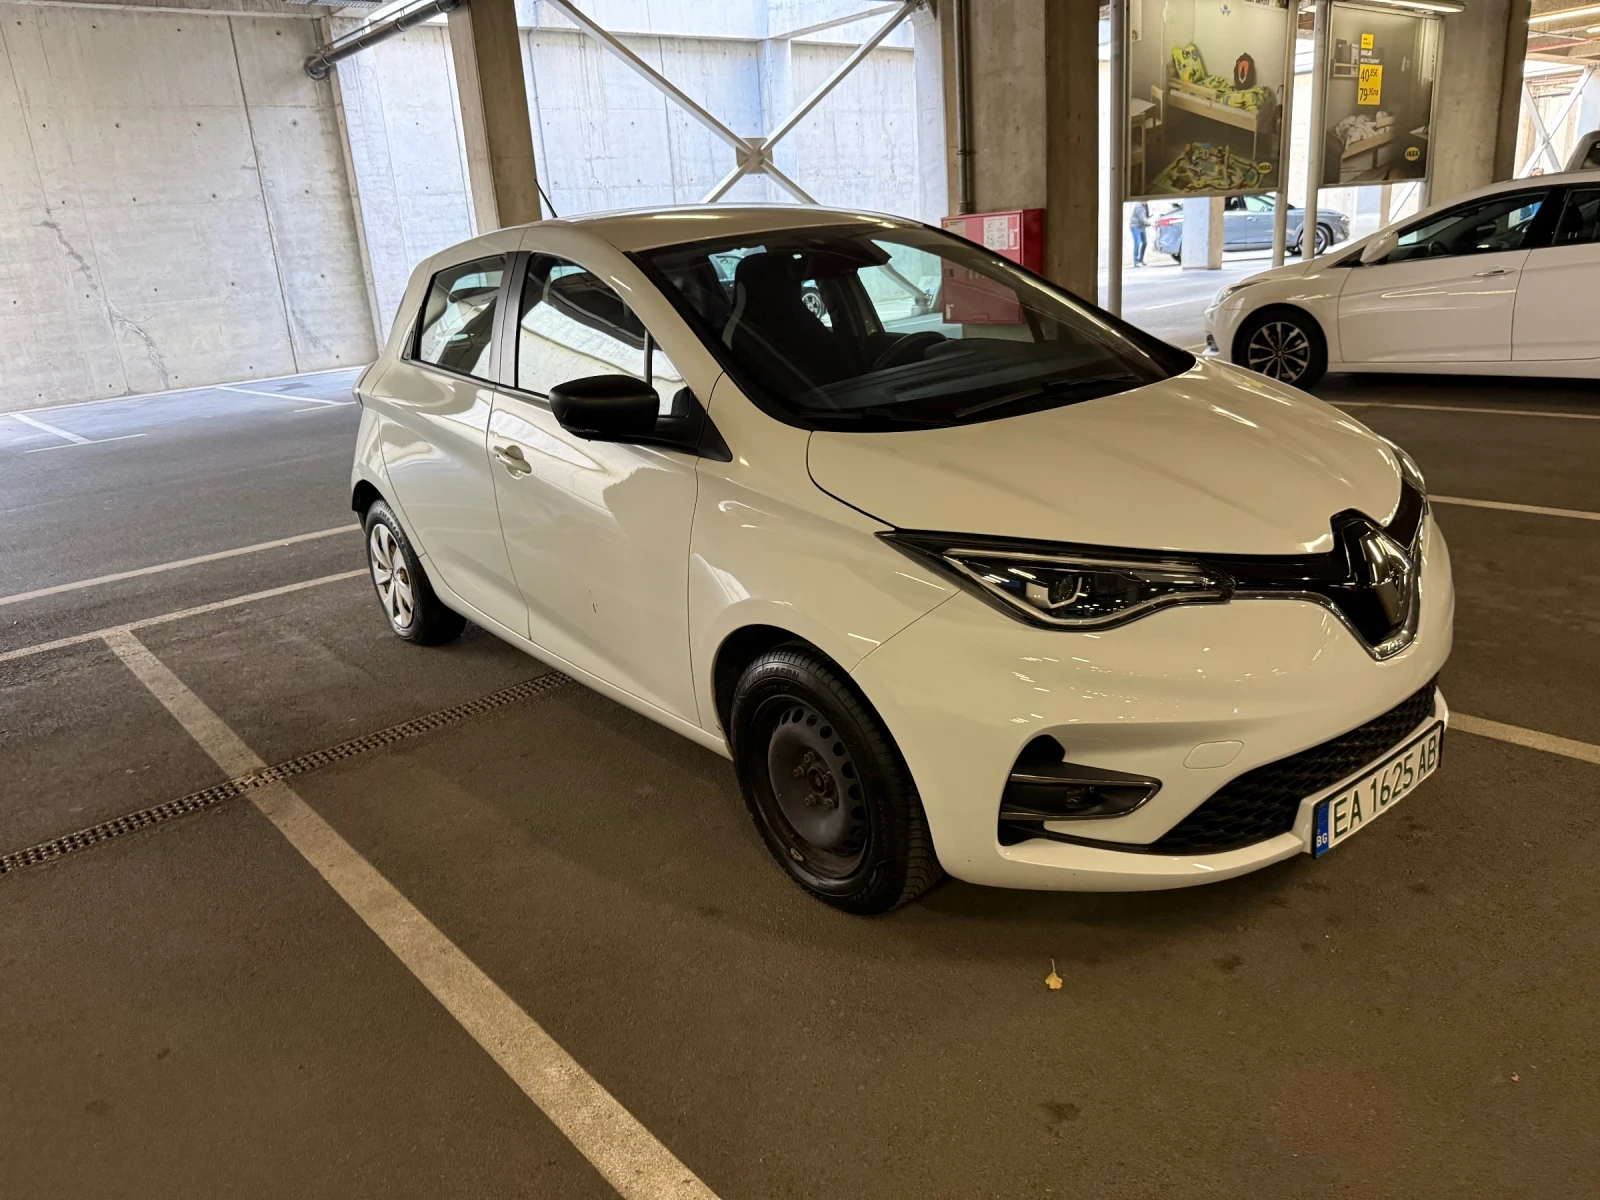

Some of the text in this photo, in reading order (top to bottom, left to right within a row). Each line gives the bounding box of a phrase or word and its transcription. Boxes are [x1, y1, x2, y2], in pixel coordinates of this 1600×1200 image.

[1332, 733, 1438, 839] EA 1625 AB
[1316, 832, 1328, 848] BG
